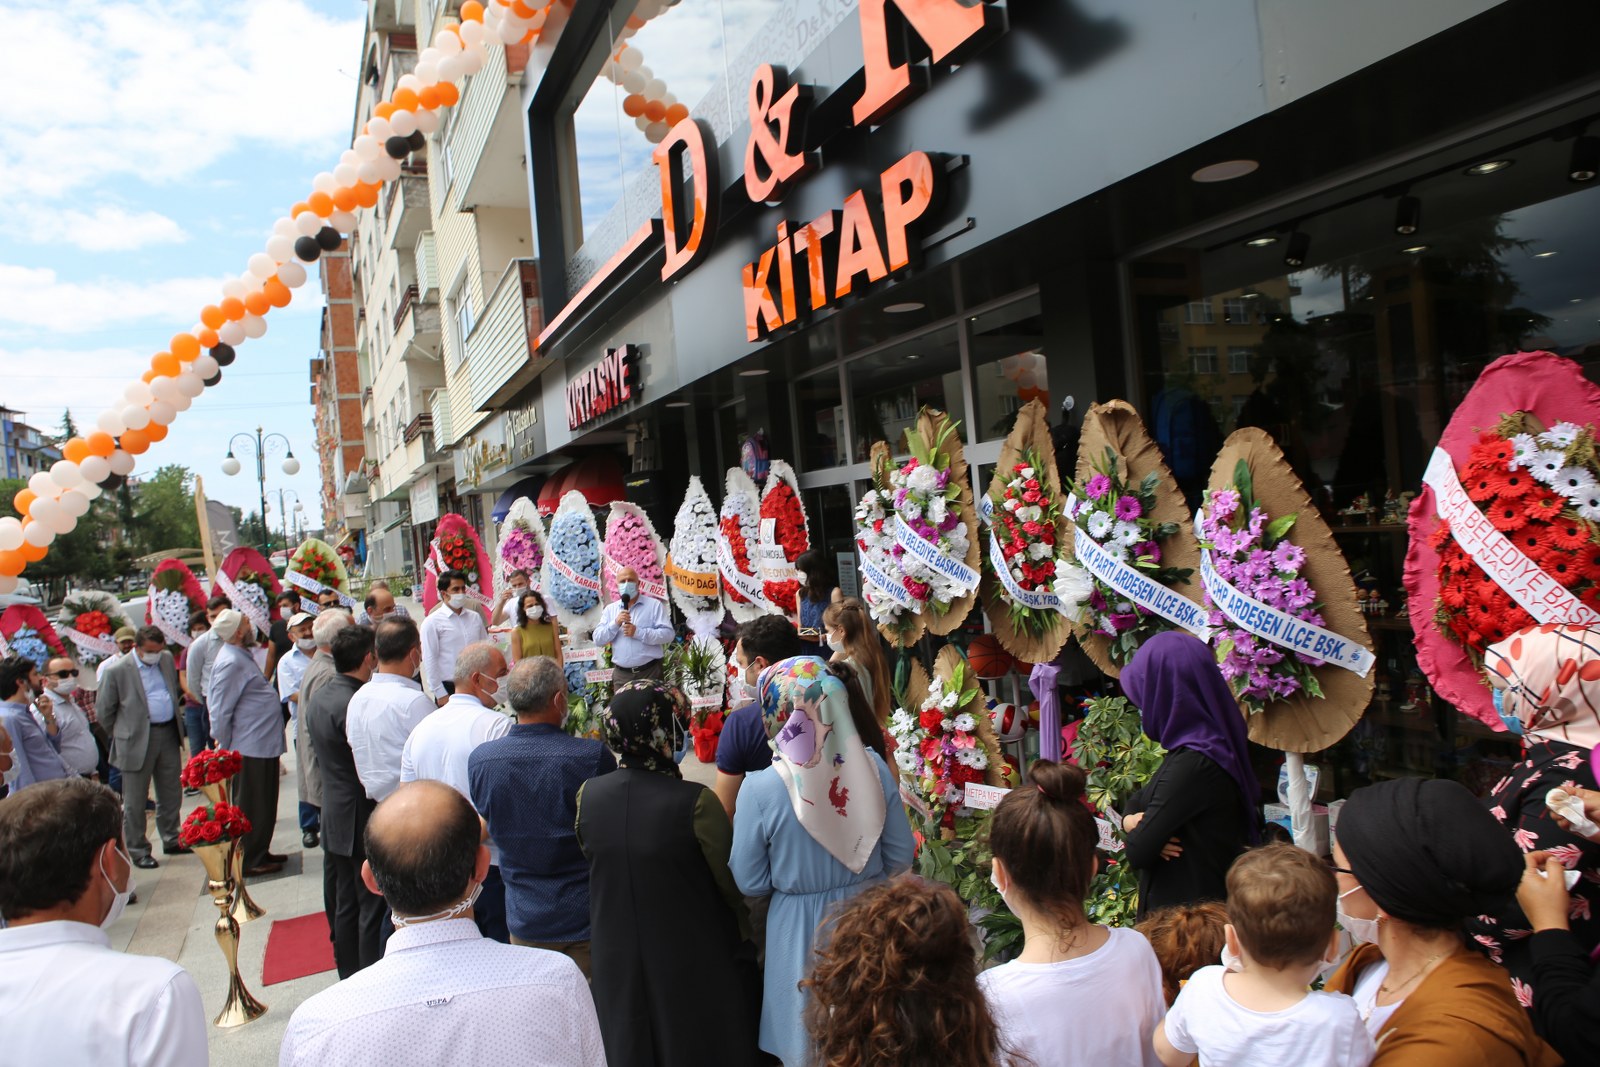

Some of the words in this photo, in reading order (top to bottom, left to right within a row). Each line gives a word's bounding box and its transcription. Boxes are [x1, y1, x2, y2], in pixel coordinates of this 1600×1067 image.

[653, 118, 708, 282] D
[744, 63, 805, 202] &
[742, 150, 934, 342] KİTAP
[565, 344, 631, 431] KIRTASİYE
[934, 555, 969, 585] BAŞKANI
[1091, 552, 1118, 579] PARTİ
[1113, 567, 1158, 603] ARDEŞEN
[1152, 586, 1178, 615] İLÇE
[1212, 576, 1230, 600] CHP
[1227, 594, 1284, 637] ARDEŞEN
[1280, 616, 1316, 649] İLÇE
[1312, 634, 1347, 661] BŞK.
